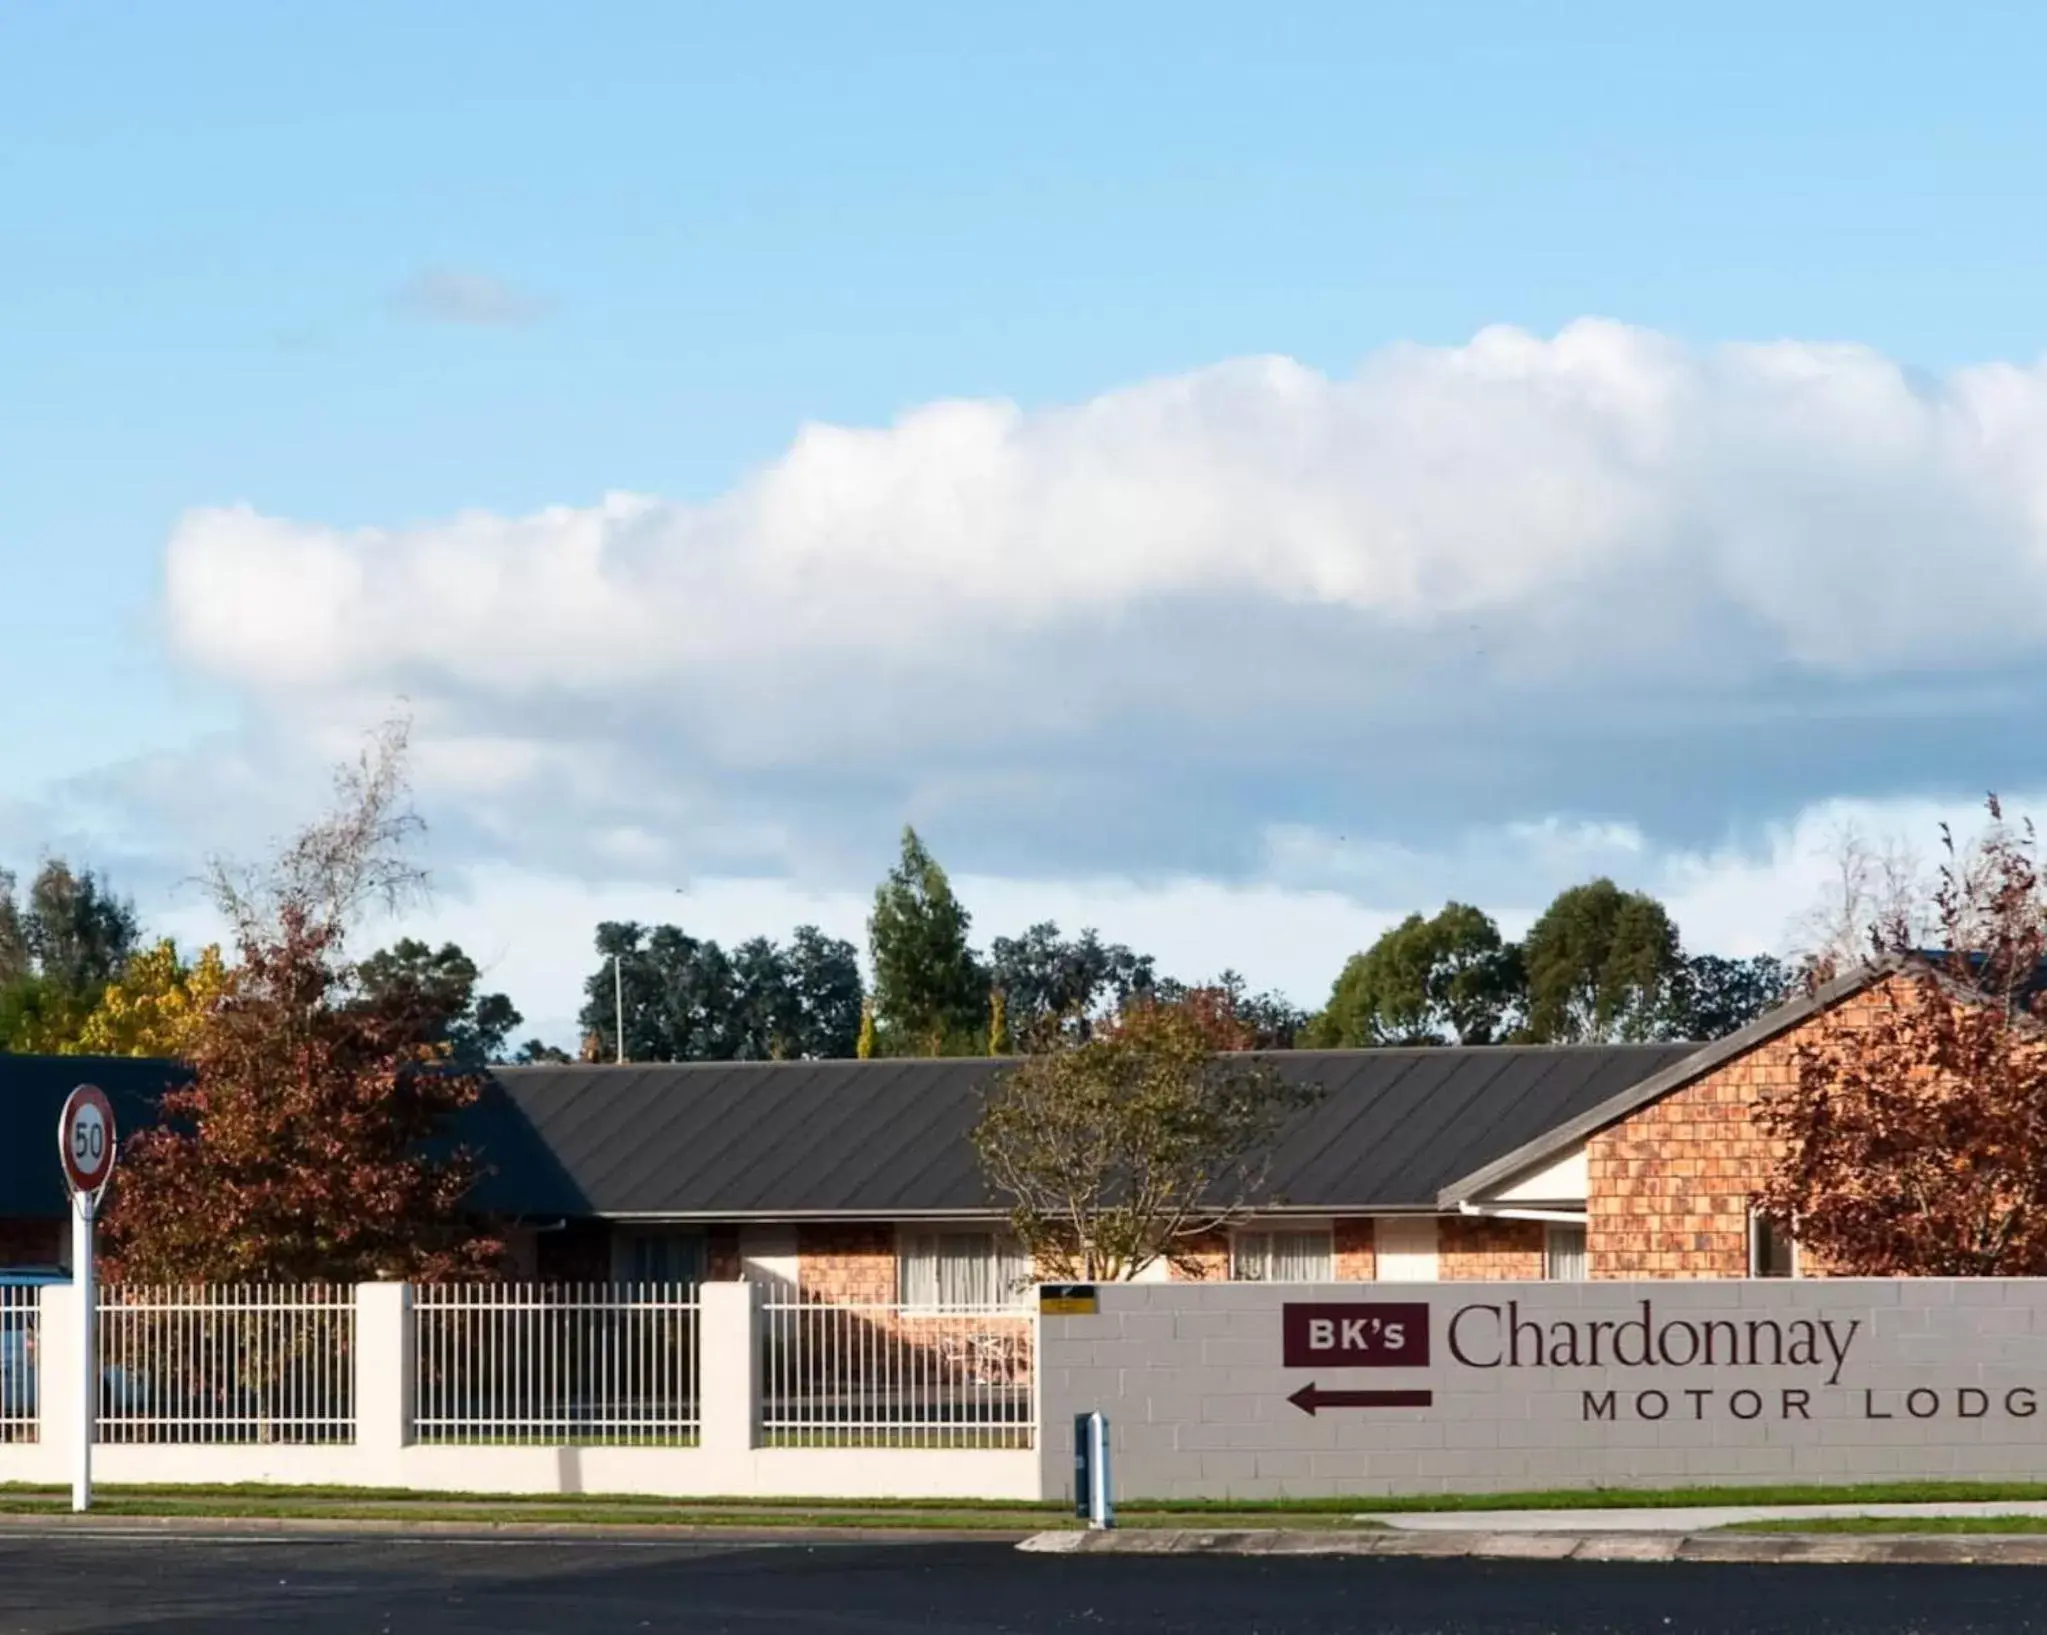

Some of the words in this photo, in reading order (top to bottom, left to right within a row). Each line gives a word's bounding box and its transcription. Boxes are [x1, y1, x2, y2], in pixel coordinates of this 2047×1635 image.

[75, 1122, 103, 1159] 50
[1308, 1318, 1405, 1350] BK's
[1447, 1299, 1861, 1386] Chardonnay
[1582, 1388, 1811, 1421] MOTOR
